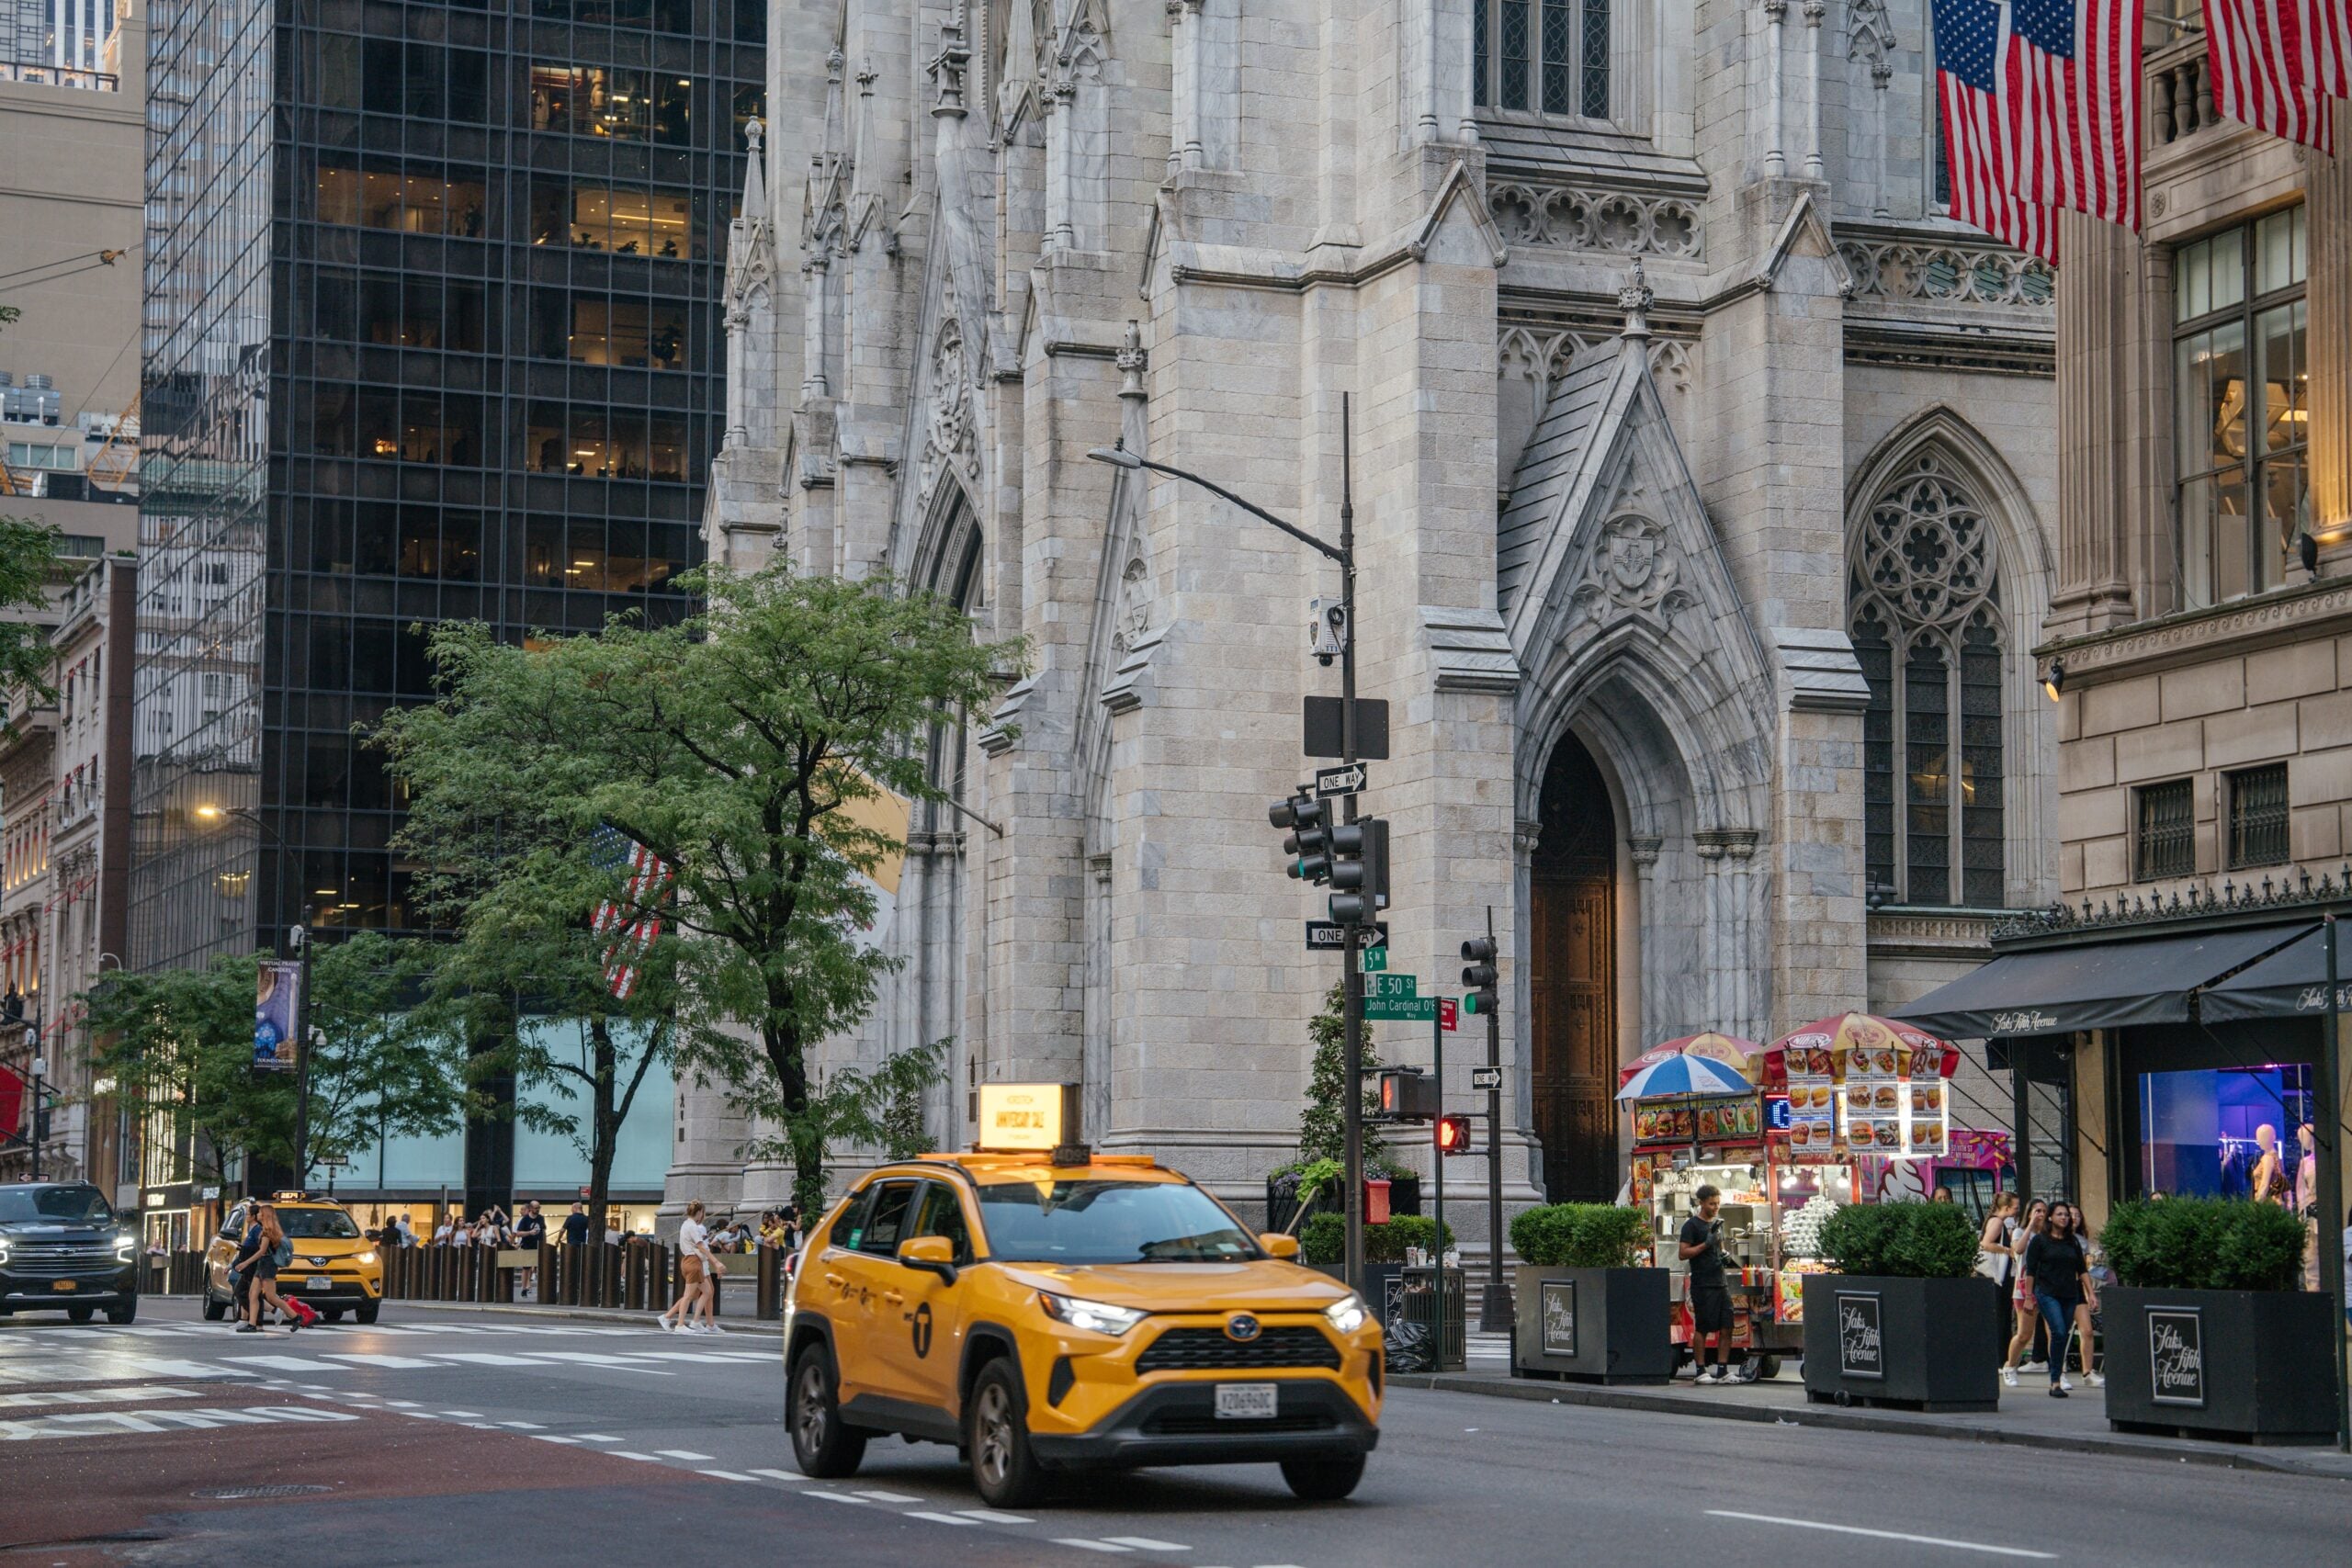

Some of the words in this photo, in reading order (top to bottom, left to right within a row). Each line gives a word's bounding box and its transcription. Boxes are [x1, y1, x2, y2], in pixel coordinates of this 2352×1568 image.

[1324, 776, 1340, 789] ONE
[1345, 771, 1360, 785] WAY
[1318, 930, 1341, 942] ONE
[1368, 951, 1374, 969] 5
[1377, 976, 1384, 994] E
[1388, 977, 1402, 995] 50
[1406, 978, 1413, 989] St
[1367, 999, 1386, 1011] John
[1389, 999, 1420, 1011] Cardinal
[1990, 1012, 2013, 1033] Saks
[2009, 1011, 2030, 1032] Fifth
[2025, 1010, 2058, 1032] Avenue
[1476, 1074, 1486, 1084] ONE
[1545, 1293, 1563, 1316] Saks
[1546, 1320, 1571, 1342] Avenue
[1841, 1306, 1866, 1333] Saks
[1854, 1326, 1880, 1349] Fifth
[2153, 1324, 2183, 1354] Saks
[1843, 1337, 1877, 1363] Avenue
[2169, 1346, 2200, 1372] Fifth
[2155, 1359, 2198, 1388] Avenue
